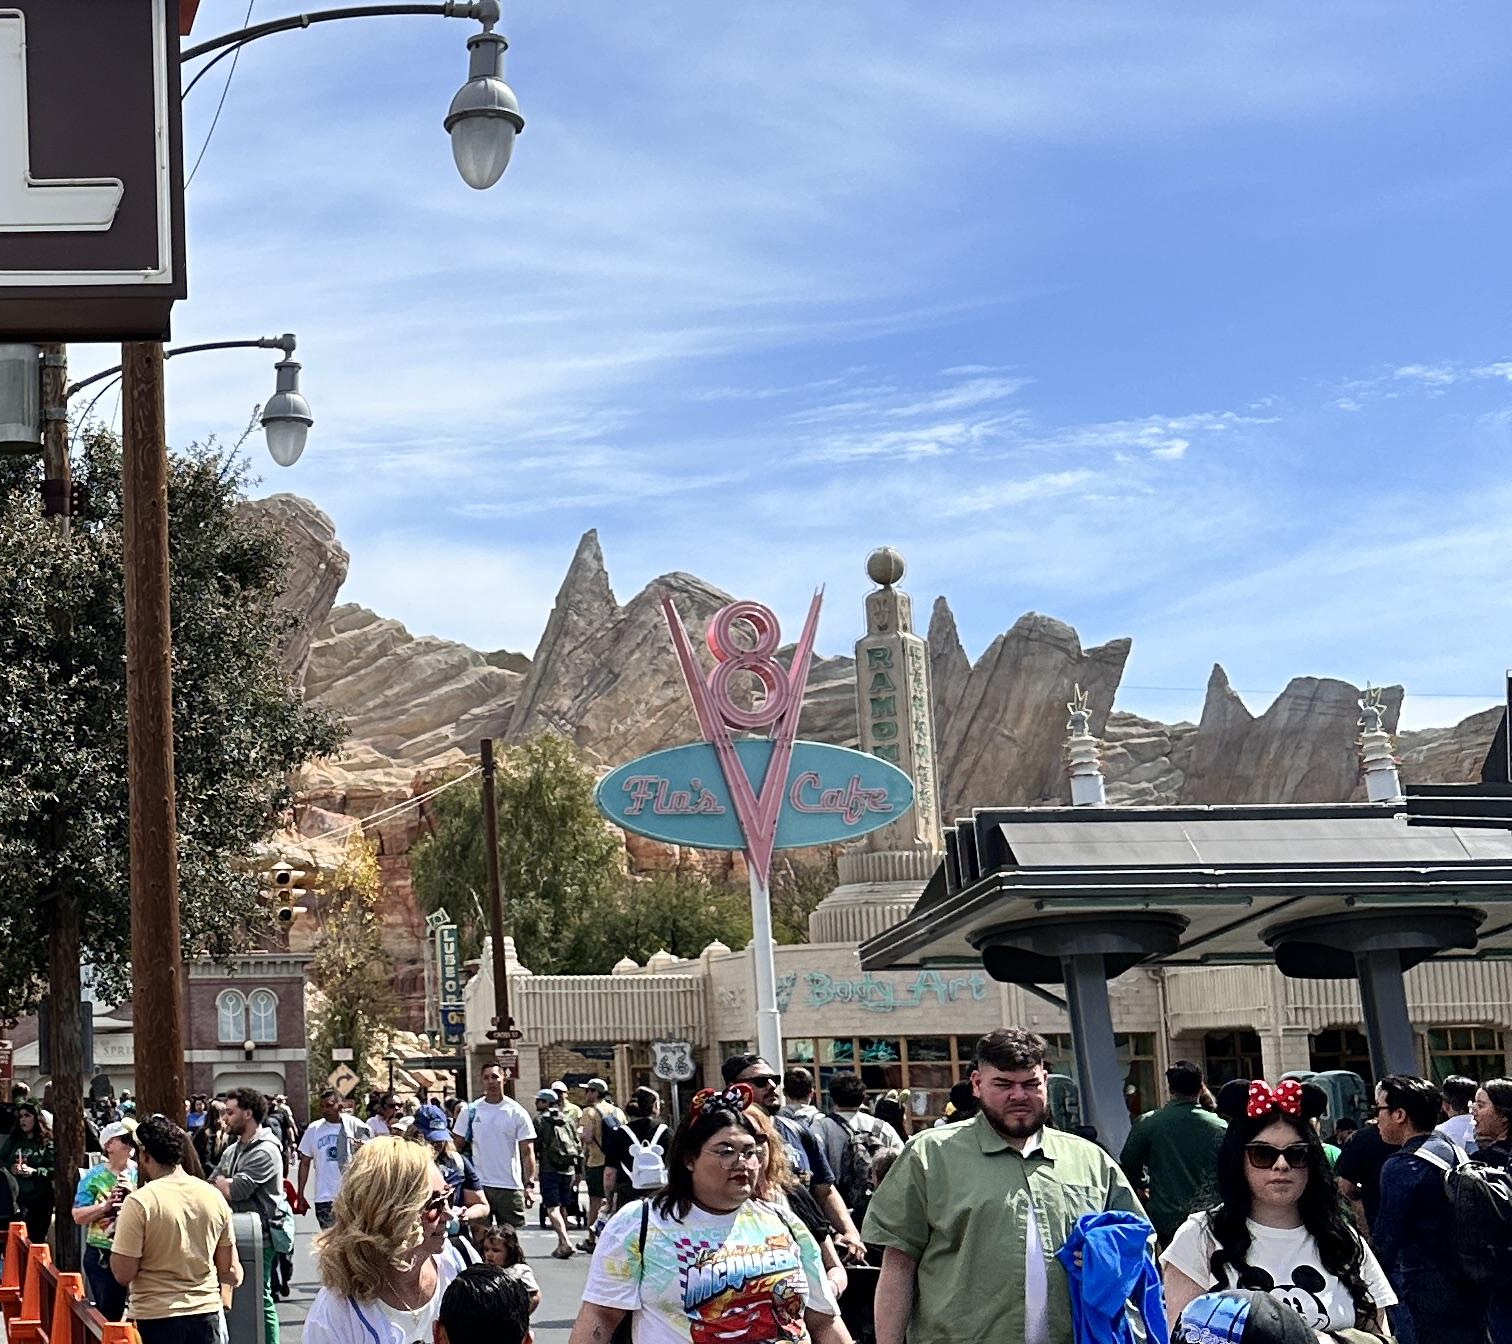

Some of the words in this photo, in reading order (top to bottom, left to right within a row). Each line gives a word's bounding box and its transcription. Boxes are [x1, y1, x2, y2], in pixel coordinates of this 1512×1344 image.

[621, 774, 726, 816] Flo's
[790, 771, 894, 826] Cafe
[804, 970, 894, 1013] Body
[904, 968, 986, 1005] Art
